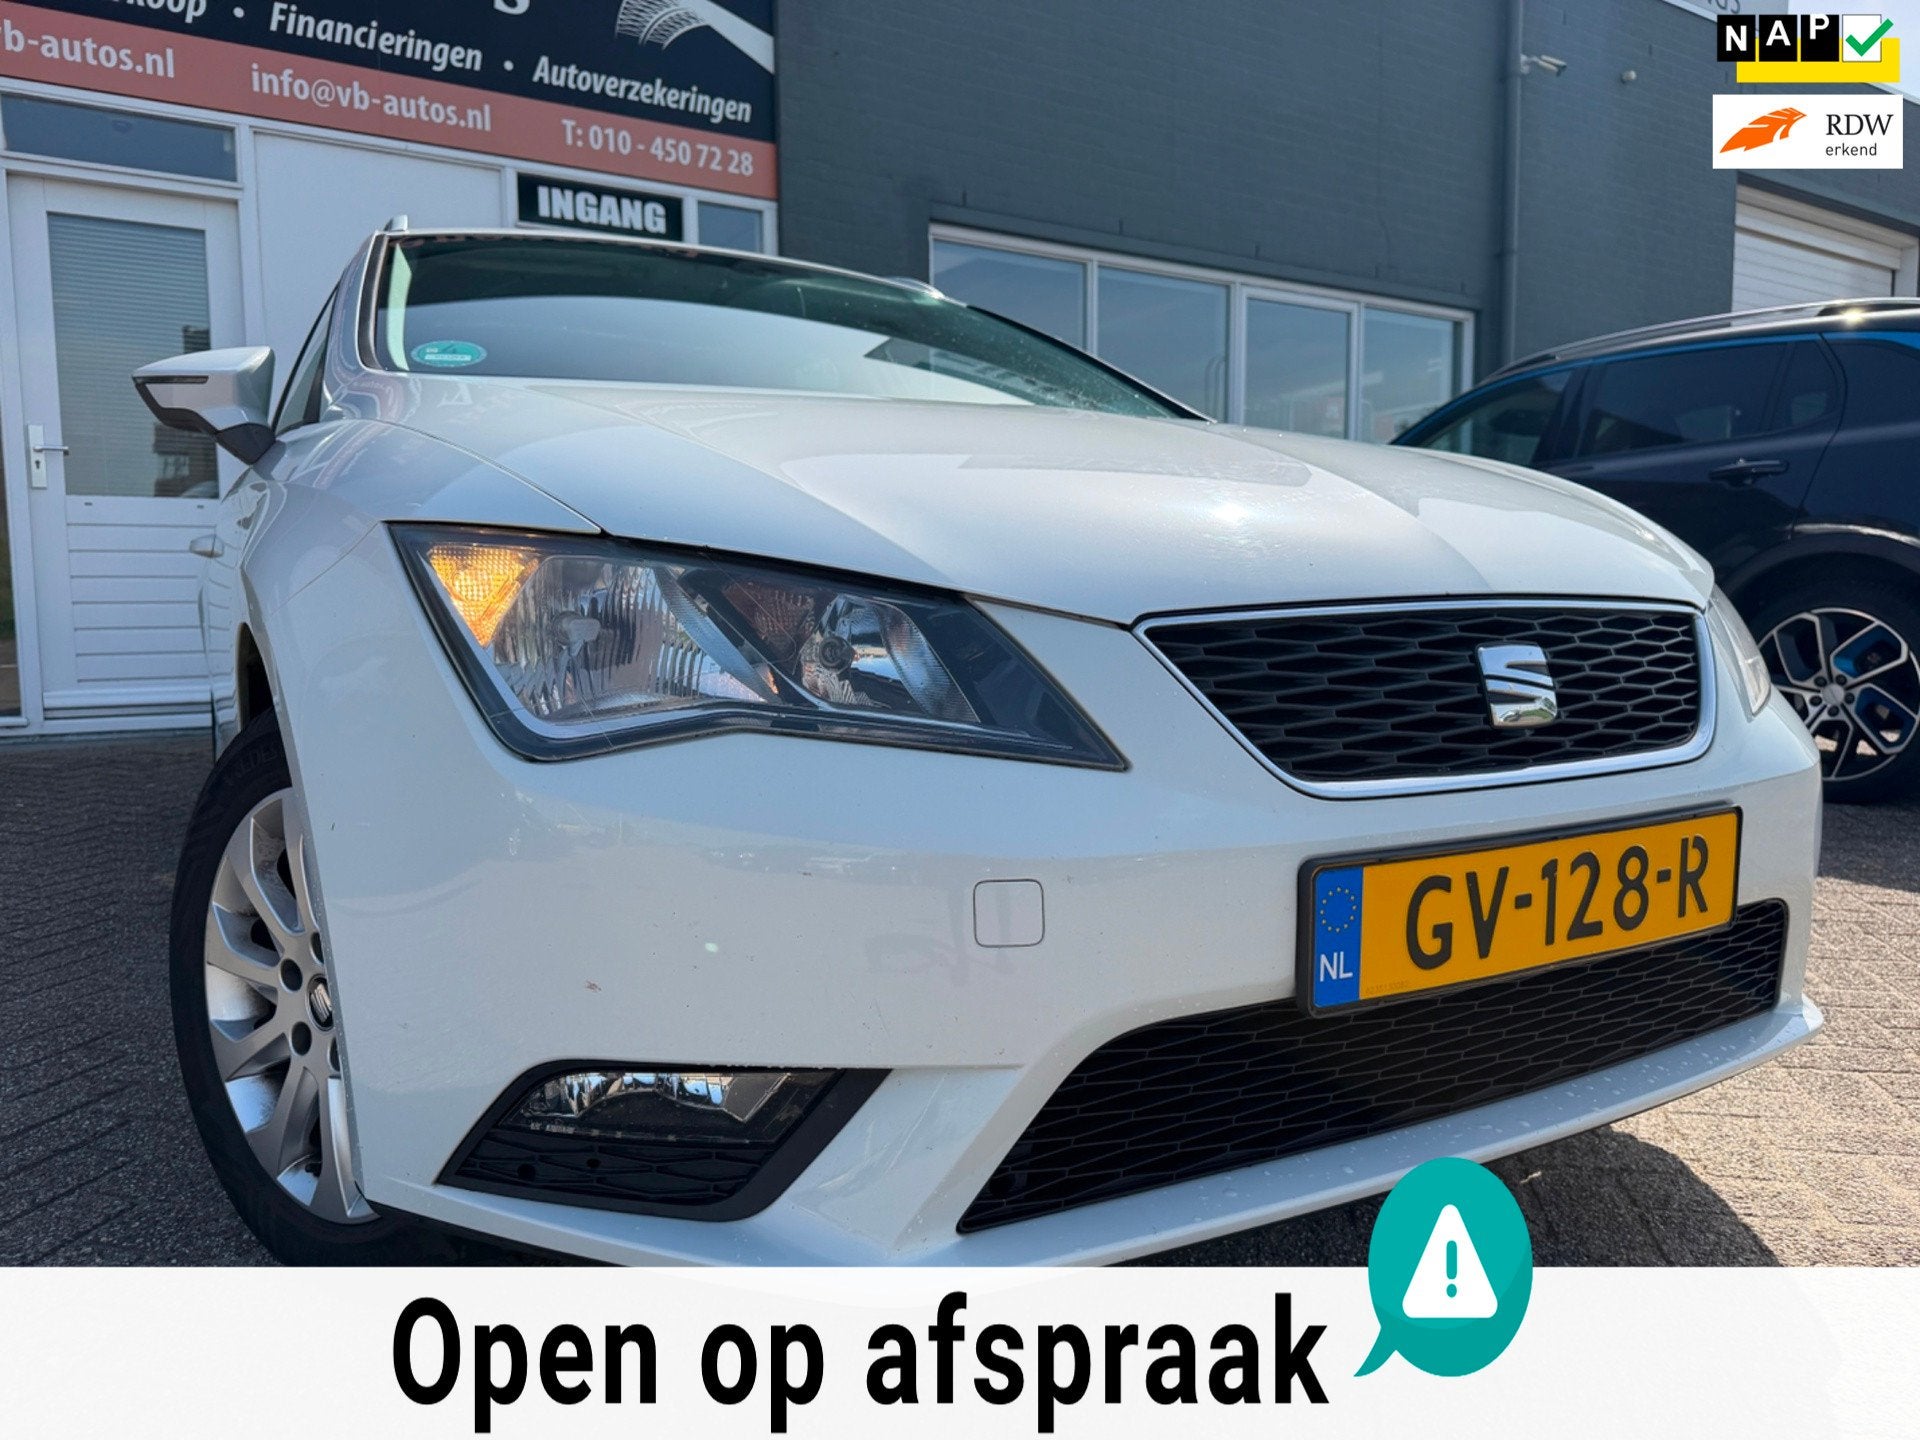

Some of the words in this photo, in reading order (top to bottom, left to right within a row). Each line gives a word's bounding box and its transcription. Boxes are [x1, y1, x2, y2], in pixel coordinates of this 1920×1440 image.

[0, 18, 175, 79] b-autos.nl
[251, 62, 492, 132] info@vb-autos.nl
[561, 118, 583, 147] T:
[589, 126, 632, 155] 010
[651, 138, 691, 166] 450
[695, 144, 722, 171] 72
[728, 149, 754, 176] 28
[269, 1, 483, 73] Financieringen
[532, 55, 752, 124] Autoverzekeringen
[537, 185, 667, 235] INGANG
[1406, 834, 1709, 970] GV-128-R
[1319, 951, 1353, 982] NL
